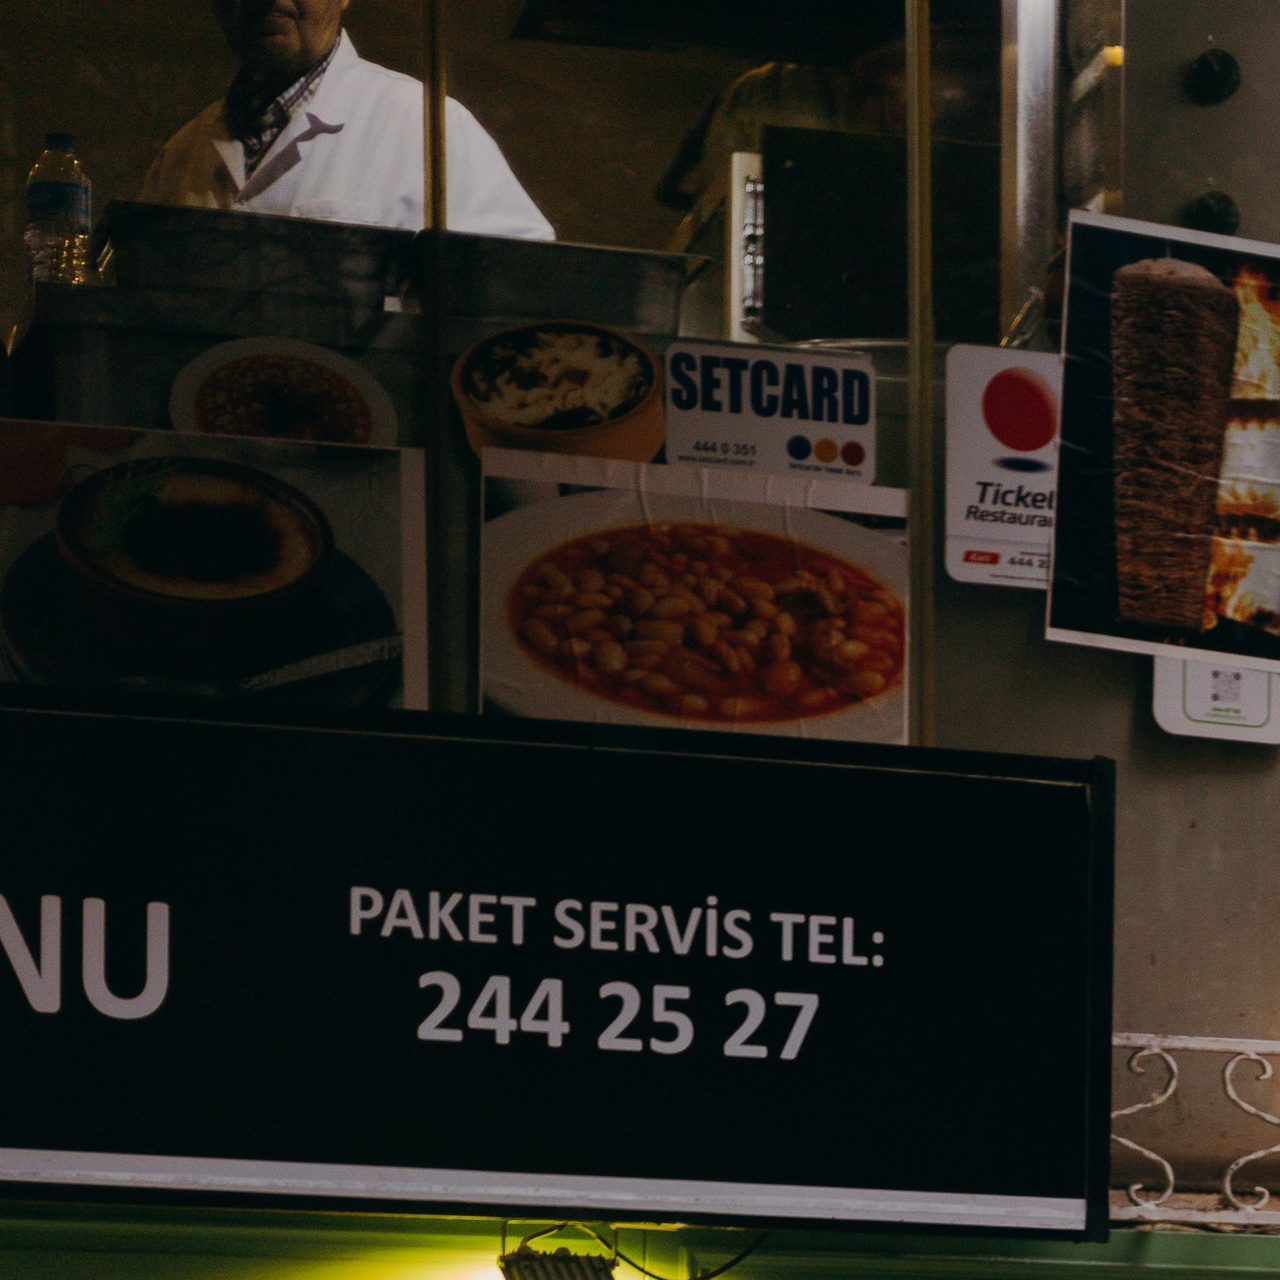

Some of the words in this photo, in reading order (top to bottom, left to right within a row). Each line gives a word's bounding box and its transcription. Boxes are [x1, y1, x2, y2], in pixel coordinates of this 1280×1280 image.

[670, 352, 870, 425] SETCARD
[0, 892, 170, 1020] NU
[350, 886, 536, 945] PAKET
[553, 896, 754, 959] SERVİS
[769, 912, 884, 967] TEL:
[417, 970, 570, 1048] 244
[597, 981, 695, 1055] 25
[723, 988, 820, 1060] 27
